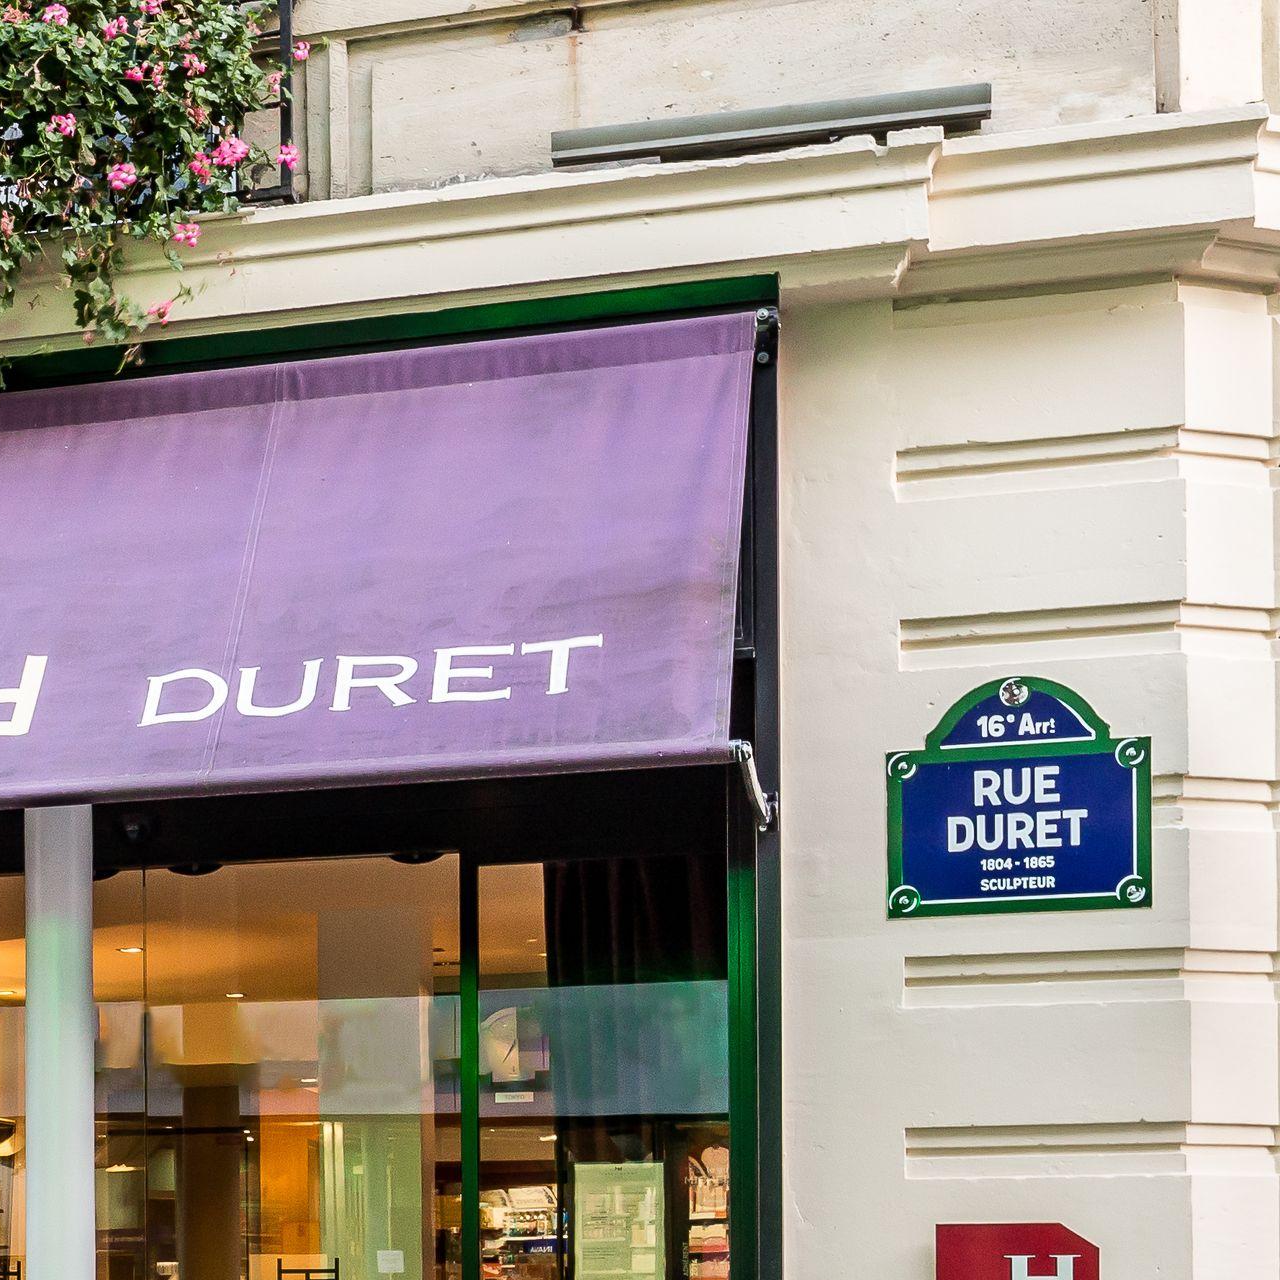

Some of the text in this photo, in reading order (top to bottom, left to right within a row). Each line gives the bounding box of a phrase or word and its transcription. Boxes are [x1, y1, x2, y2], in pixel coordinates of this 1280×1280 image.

[136, 633, 604, 728] DURET
[973, 765, 1062, 807] RUE
[946, 808, 1089, 853] DURET
[980, 858, 1013, 871] 1804
[1023, 856, 1056, 869] 1865
[980, 875, 1056, 891] SCULPTEUR
